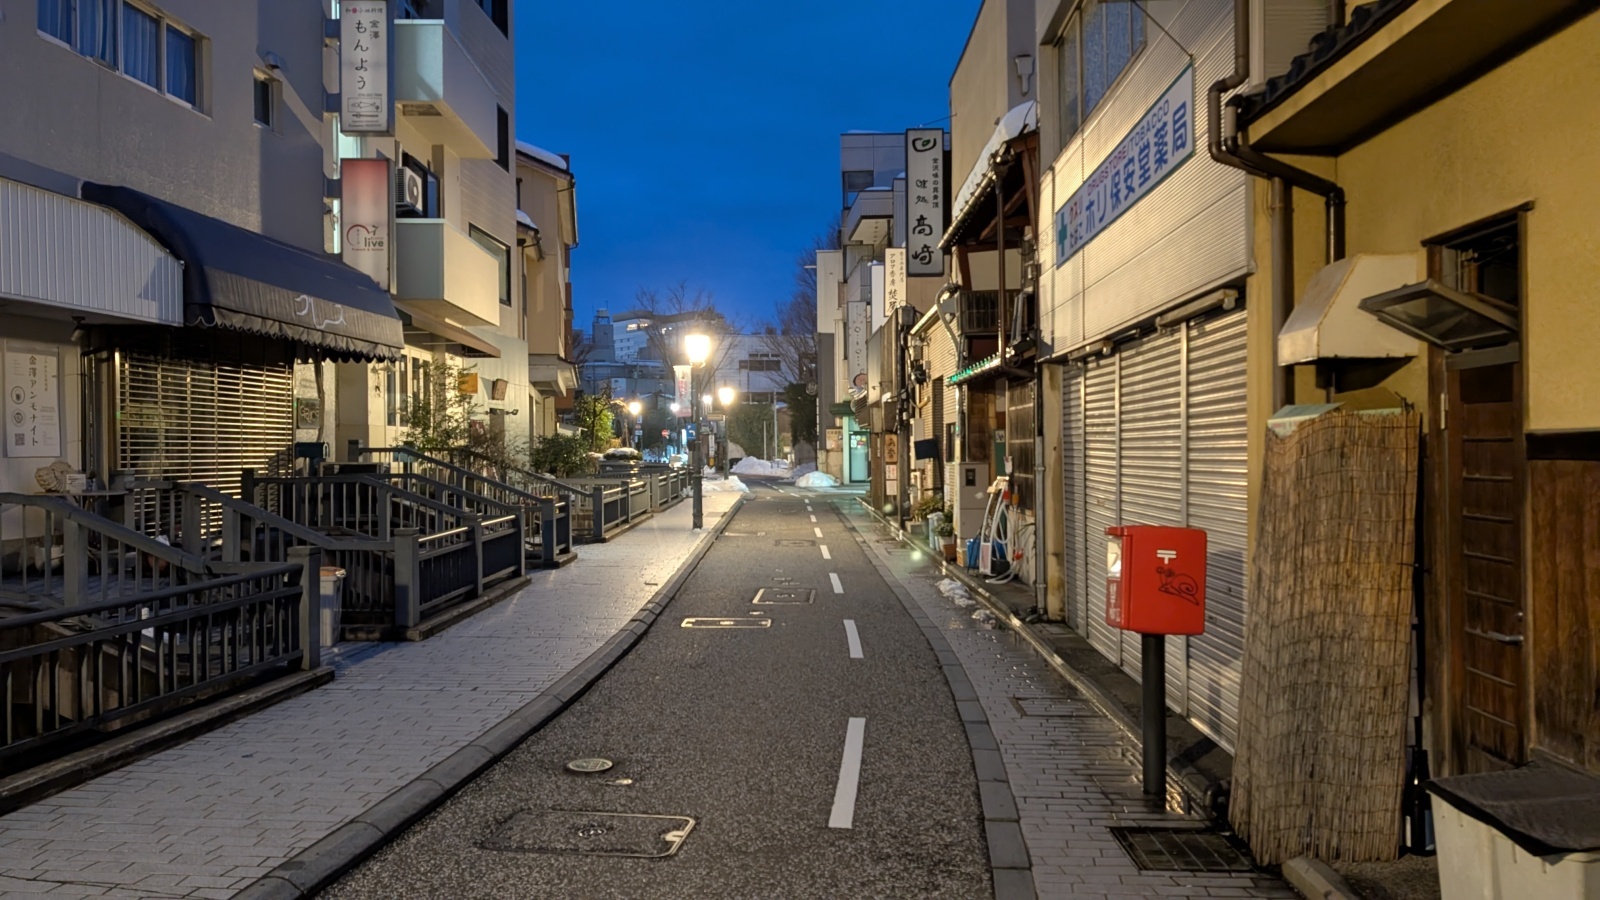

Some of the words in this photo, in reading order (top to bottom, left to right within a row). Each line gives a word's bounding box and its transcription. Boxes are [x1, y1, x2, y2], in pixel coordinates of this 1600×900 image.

[353, 19, 369, 90] もんよう
[369, 19, 380, 39] 金澤
[1085, 100, 1188, 235] ホリ保安堂薬局
[28, 354, 39, 447] 金澤アンモナイト
